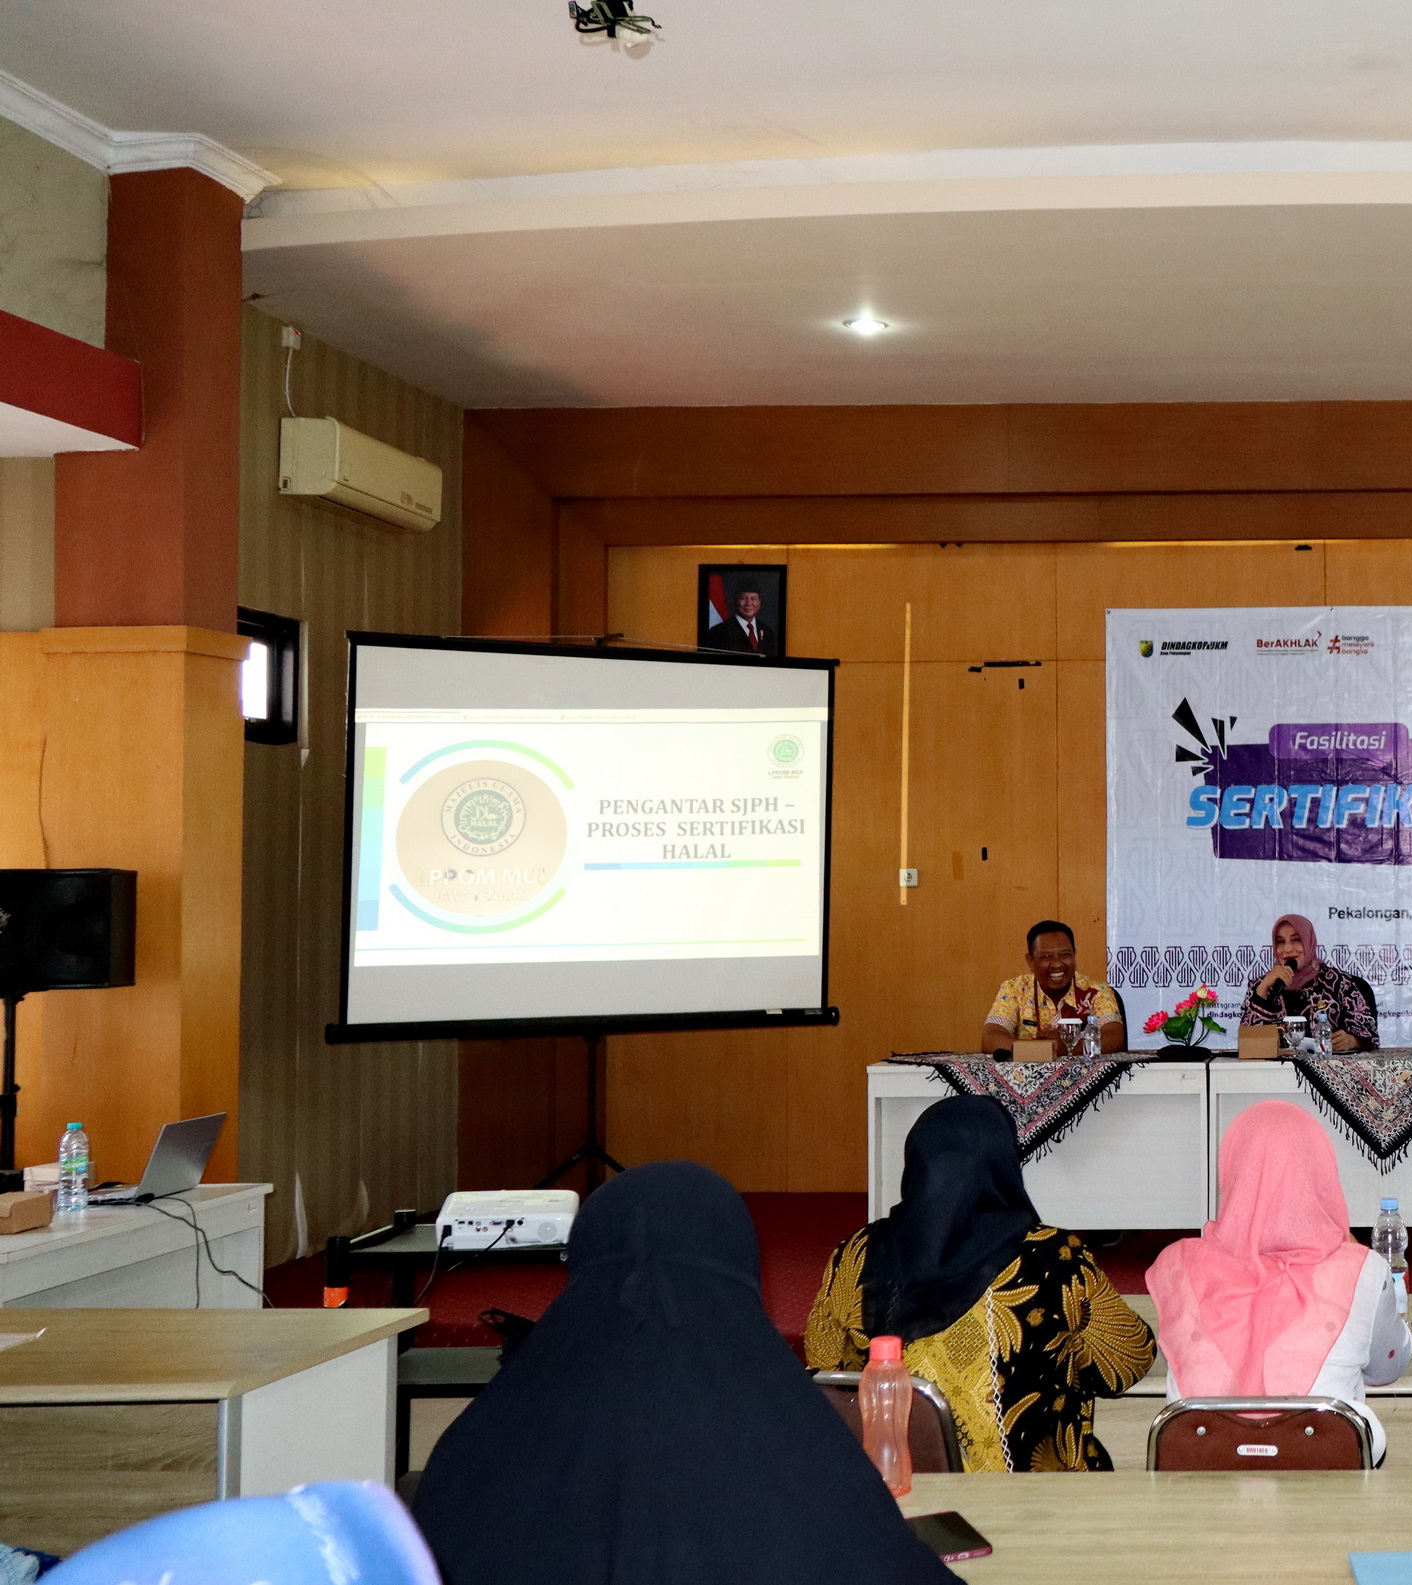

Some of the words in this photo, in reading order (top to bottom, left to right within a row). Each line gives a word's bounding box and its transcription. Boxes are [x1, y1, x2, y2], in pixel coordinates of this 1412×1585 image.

[1256, 638, 1319, 648] BerAKHLAK
[1295, 731, 1387, 750] Fasilitasi
[445, 780, 488, 813] MAJELIS
[493, 781, 522, 813] ULAMA
[599, 798, 725, 815] PENGANTAR
[731, 797, 779, 816] SJPH
[587, 821, 667, 837] PROSES
[676, 819, 806, 836] SERTIFIKASI
[450, 833, 516, 854] INDONESIA
[662, 843, 732, 859] HALAL
[1328, 907, 1412, 921] Pekalongan,
